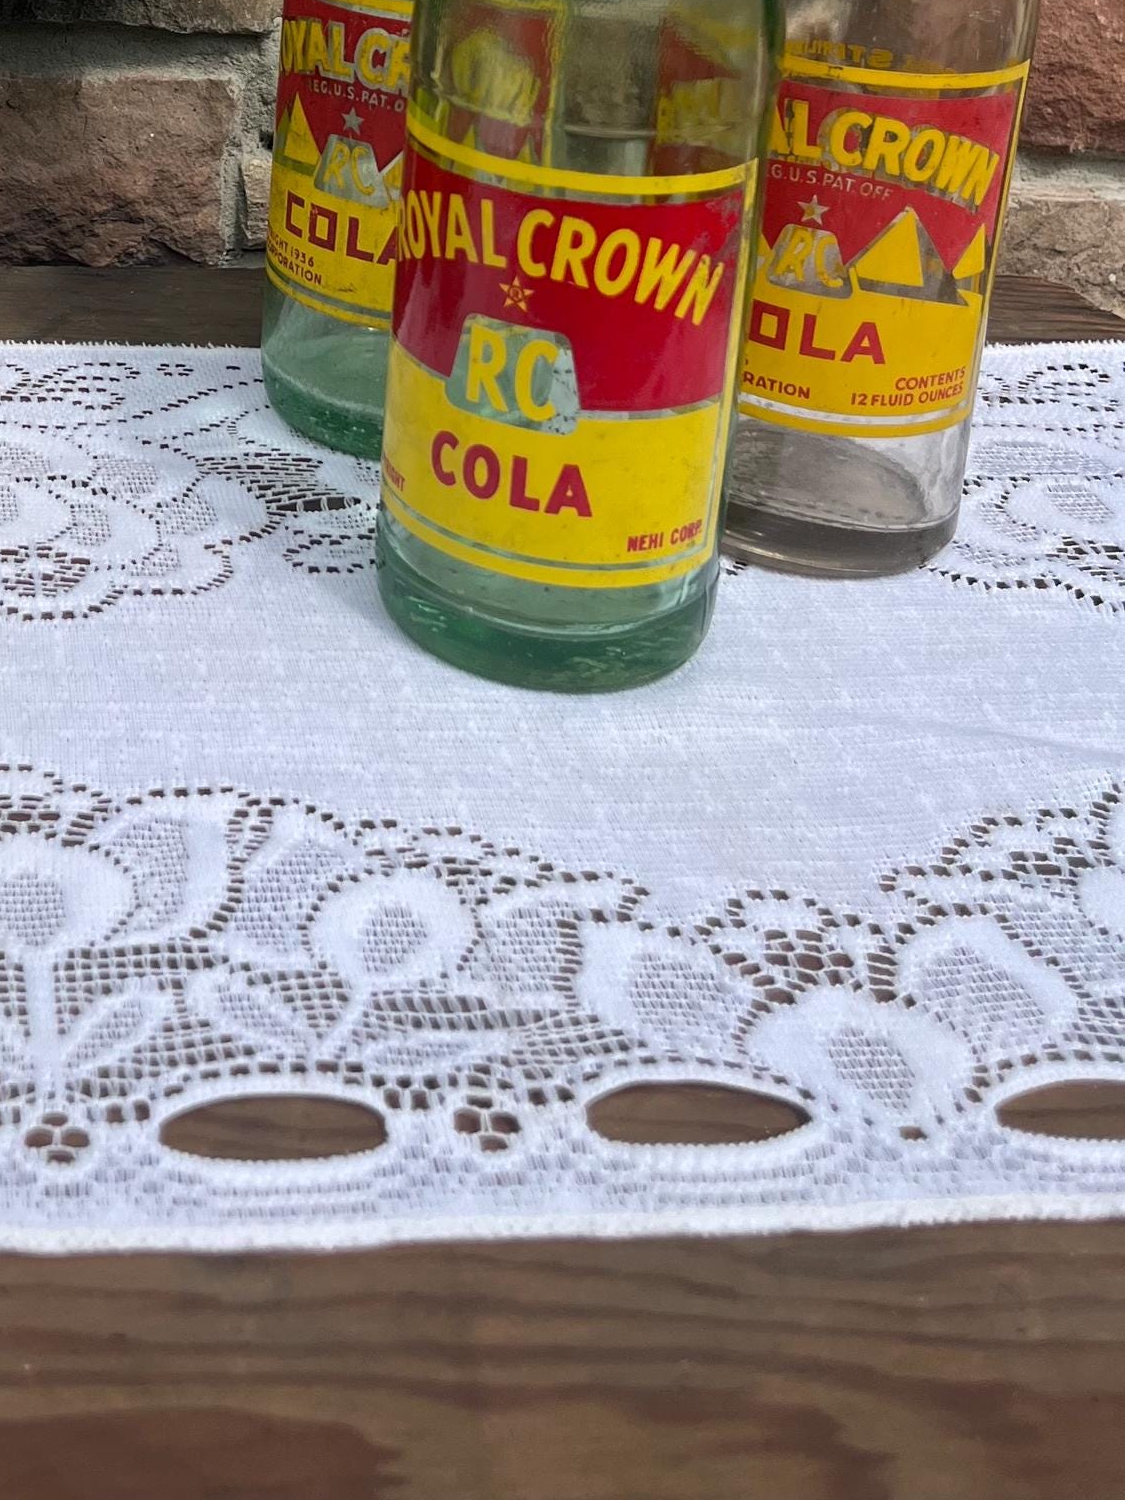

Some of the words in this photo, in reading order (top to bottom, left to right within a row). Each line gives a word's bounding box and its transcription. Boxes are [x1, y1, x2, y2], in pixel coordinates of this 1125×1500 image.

[323, 141, 374, 196] RC
[830, 111, 1001, 206] CROWN
[859, 181, 892, 200] OFF
[290, 246, 315, 267] 1936
[398, 188, 508, 269] ROYAL
[516, 208, 725, 327] CROWN
[774, 231, 845, 288] RC
[748, 298, 887, 365] OLA
[465, 325, 560, 422] RC
[743, 371, 811, 400] RATION
[850, 392, 868, 406] 12
[870, 390, 914, 407] FLUID
[917, 382, 964, 405] OUNCES
[895, 366, 967, 391] CONTENTS
[431, 430, 593, 518] COLA
[627, 532, 664, 552] NEHI
